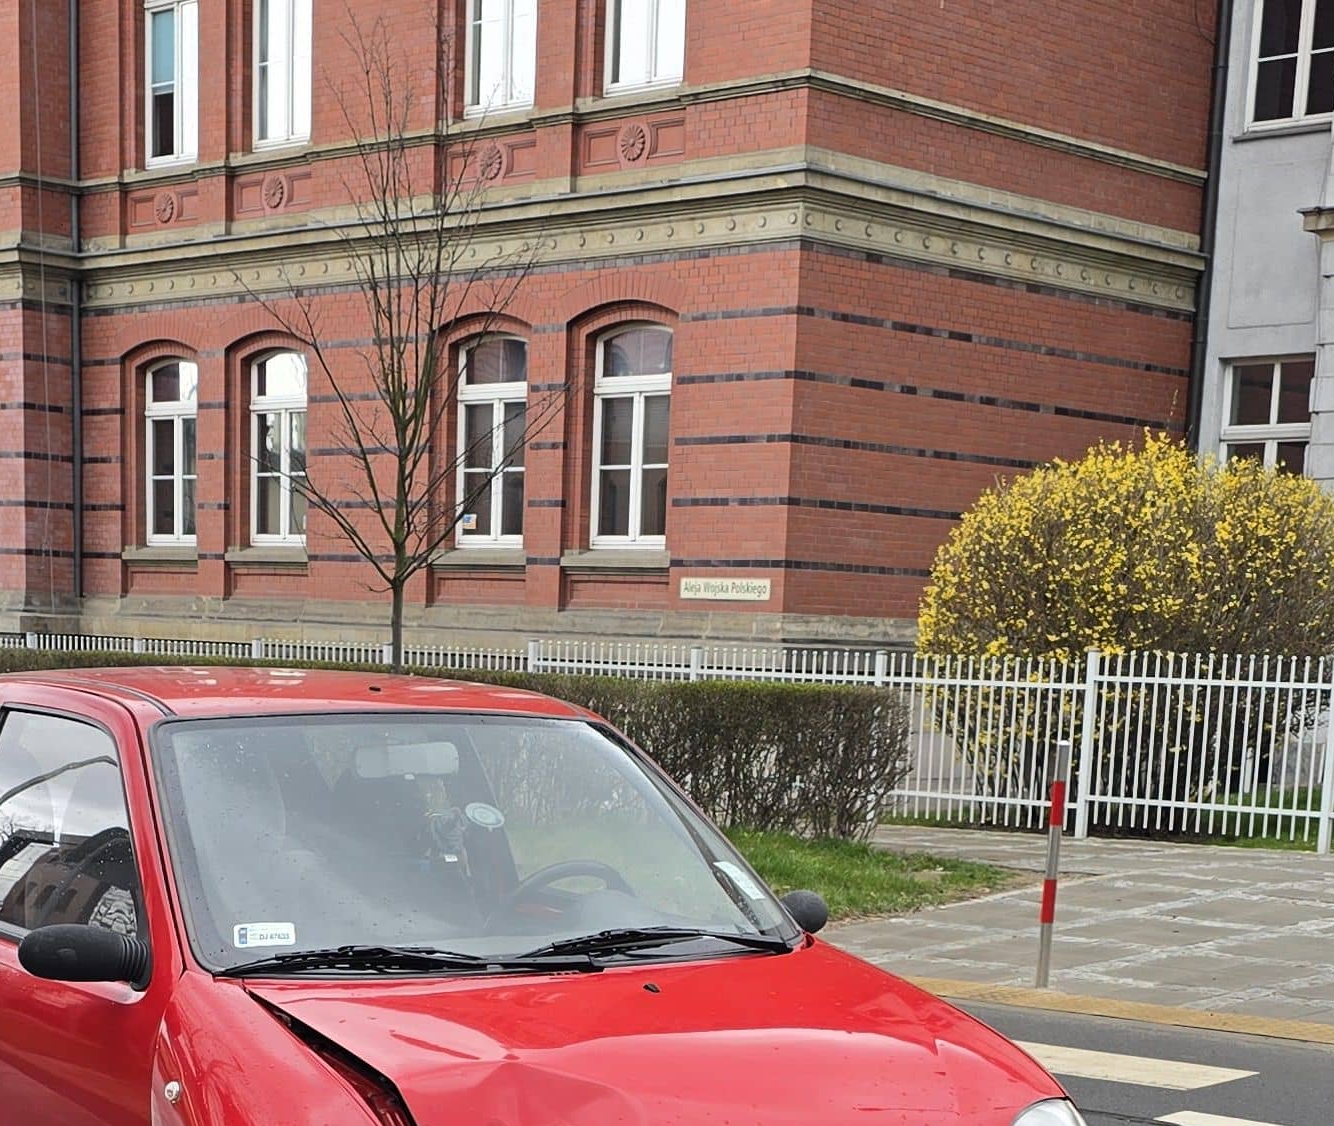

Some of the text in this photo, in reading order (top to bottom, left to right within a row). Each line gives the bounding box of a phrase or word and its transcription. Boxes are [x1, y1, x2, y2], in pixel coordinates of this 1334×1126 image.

[683, 580, 767, 598] Aleja Wojska Polskiego
